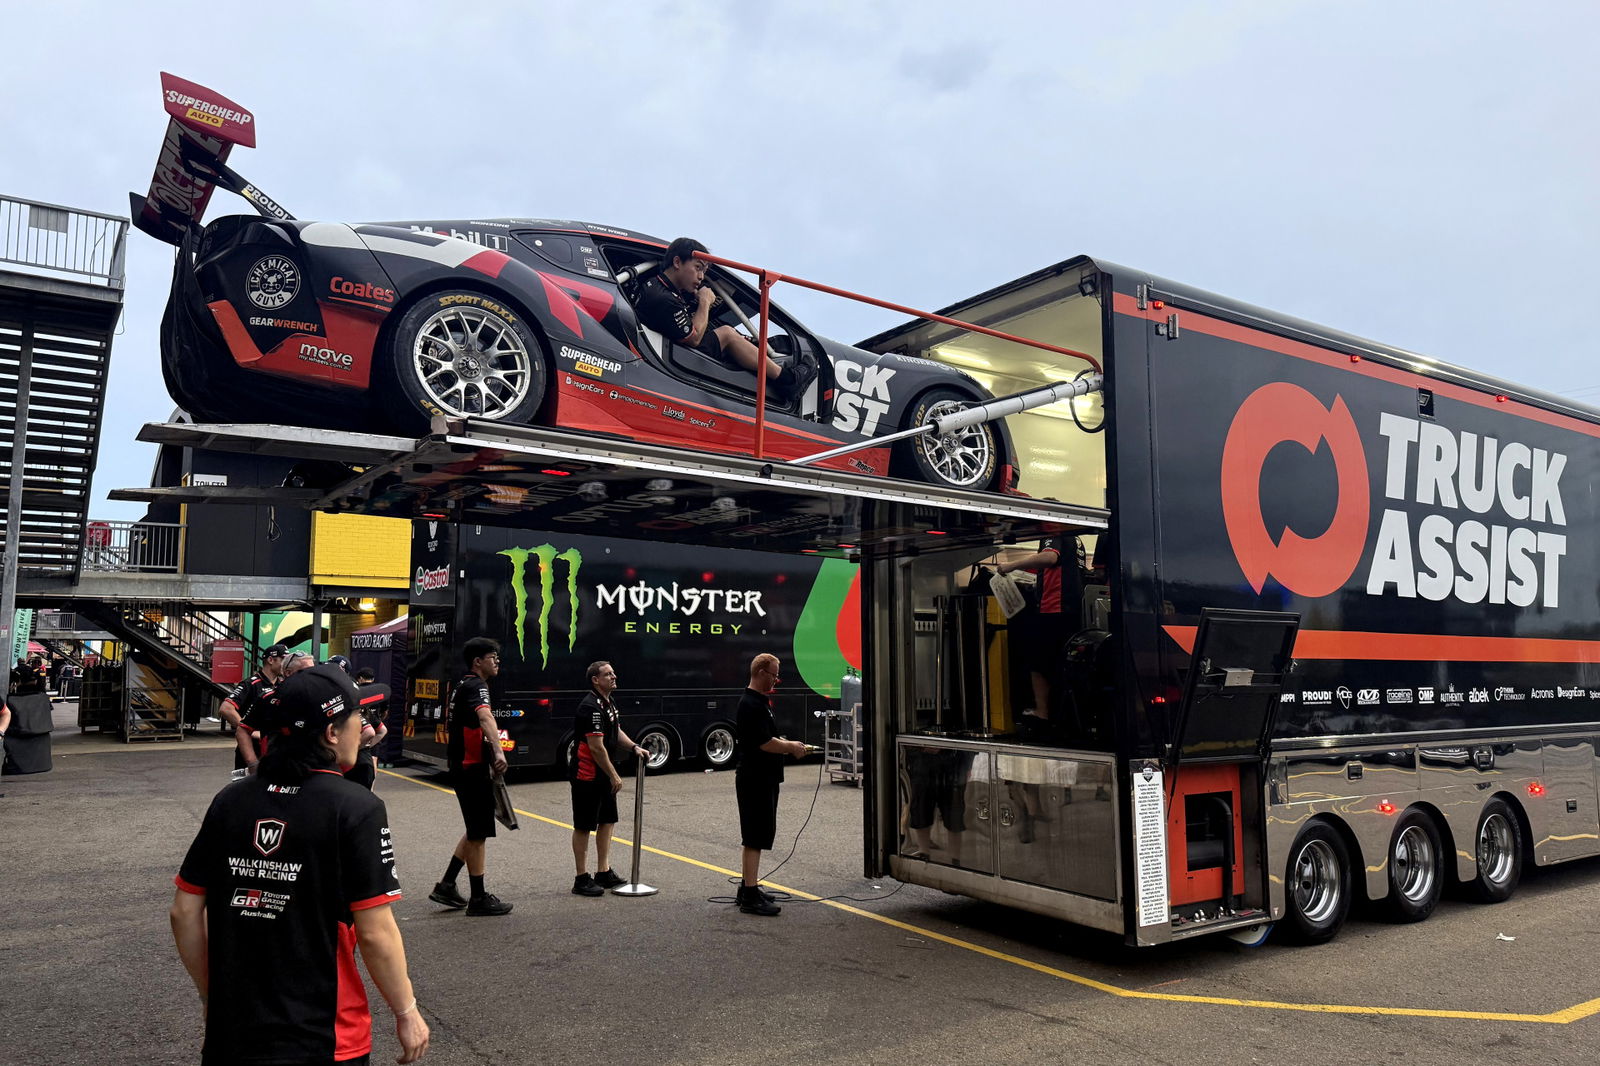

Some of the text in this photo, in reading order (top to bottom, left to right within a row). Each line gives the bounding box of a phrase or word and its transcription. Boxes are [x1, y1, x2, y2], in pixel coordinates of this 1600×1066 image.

[167, 90, 252, 125] SUPERCHEAP
[190, 111, 219, 124] AUTO
[250, 258, 296, 284] CHEMICAL
[330, 276, 394, 303] Coates
[256, 293, 285, 306] GUYS
[439, 295, 517, 323] SPORT MAXX
[249, 316, 318, 332] GEARWRENCH
[300, 343, 353, 366] move
[560, 345, 622, 373] SUPERCHEAP
[578, 363, 599, 374] AUTO
[1380, 412, 1567, 526] TRUCK
[1366, 507, 1567, 609] ASSIST
[424, 564, 450, 590] Castrol
[596, 580, 766, 617] MONSTER
[624, 622, 742, 635] ENERGY
[1531, 687, 1554, 698] Acronis
[267, 784, 290, 794] Mobil
[228, 857, 302, 873] WALKINSHAW
[231, 867, 297, 881] TWG RACING
[233, 895, 259, 906] GR
[261, 897, 286, 905] GAZOO
[263, 891, 290, 900] TOYOTA
[240, 909, 276, 919] Australia
